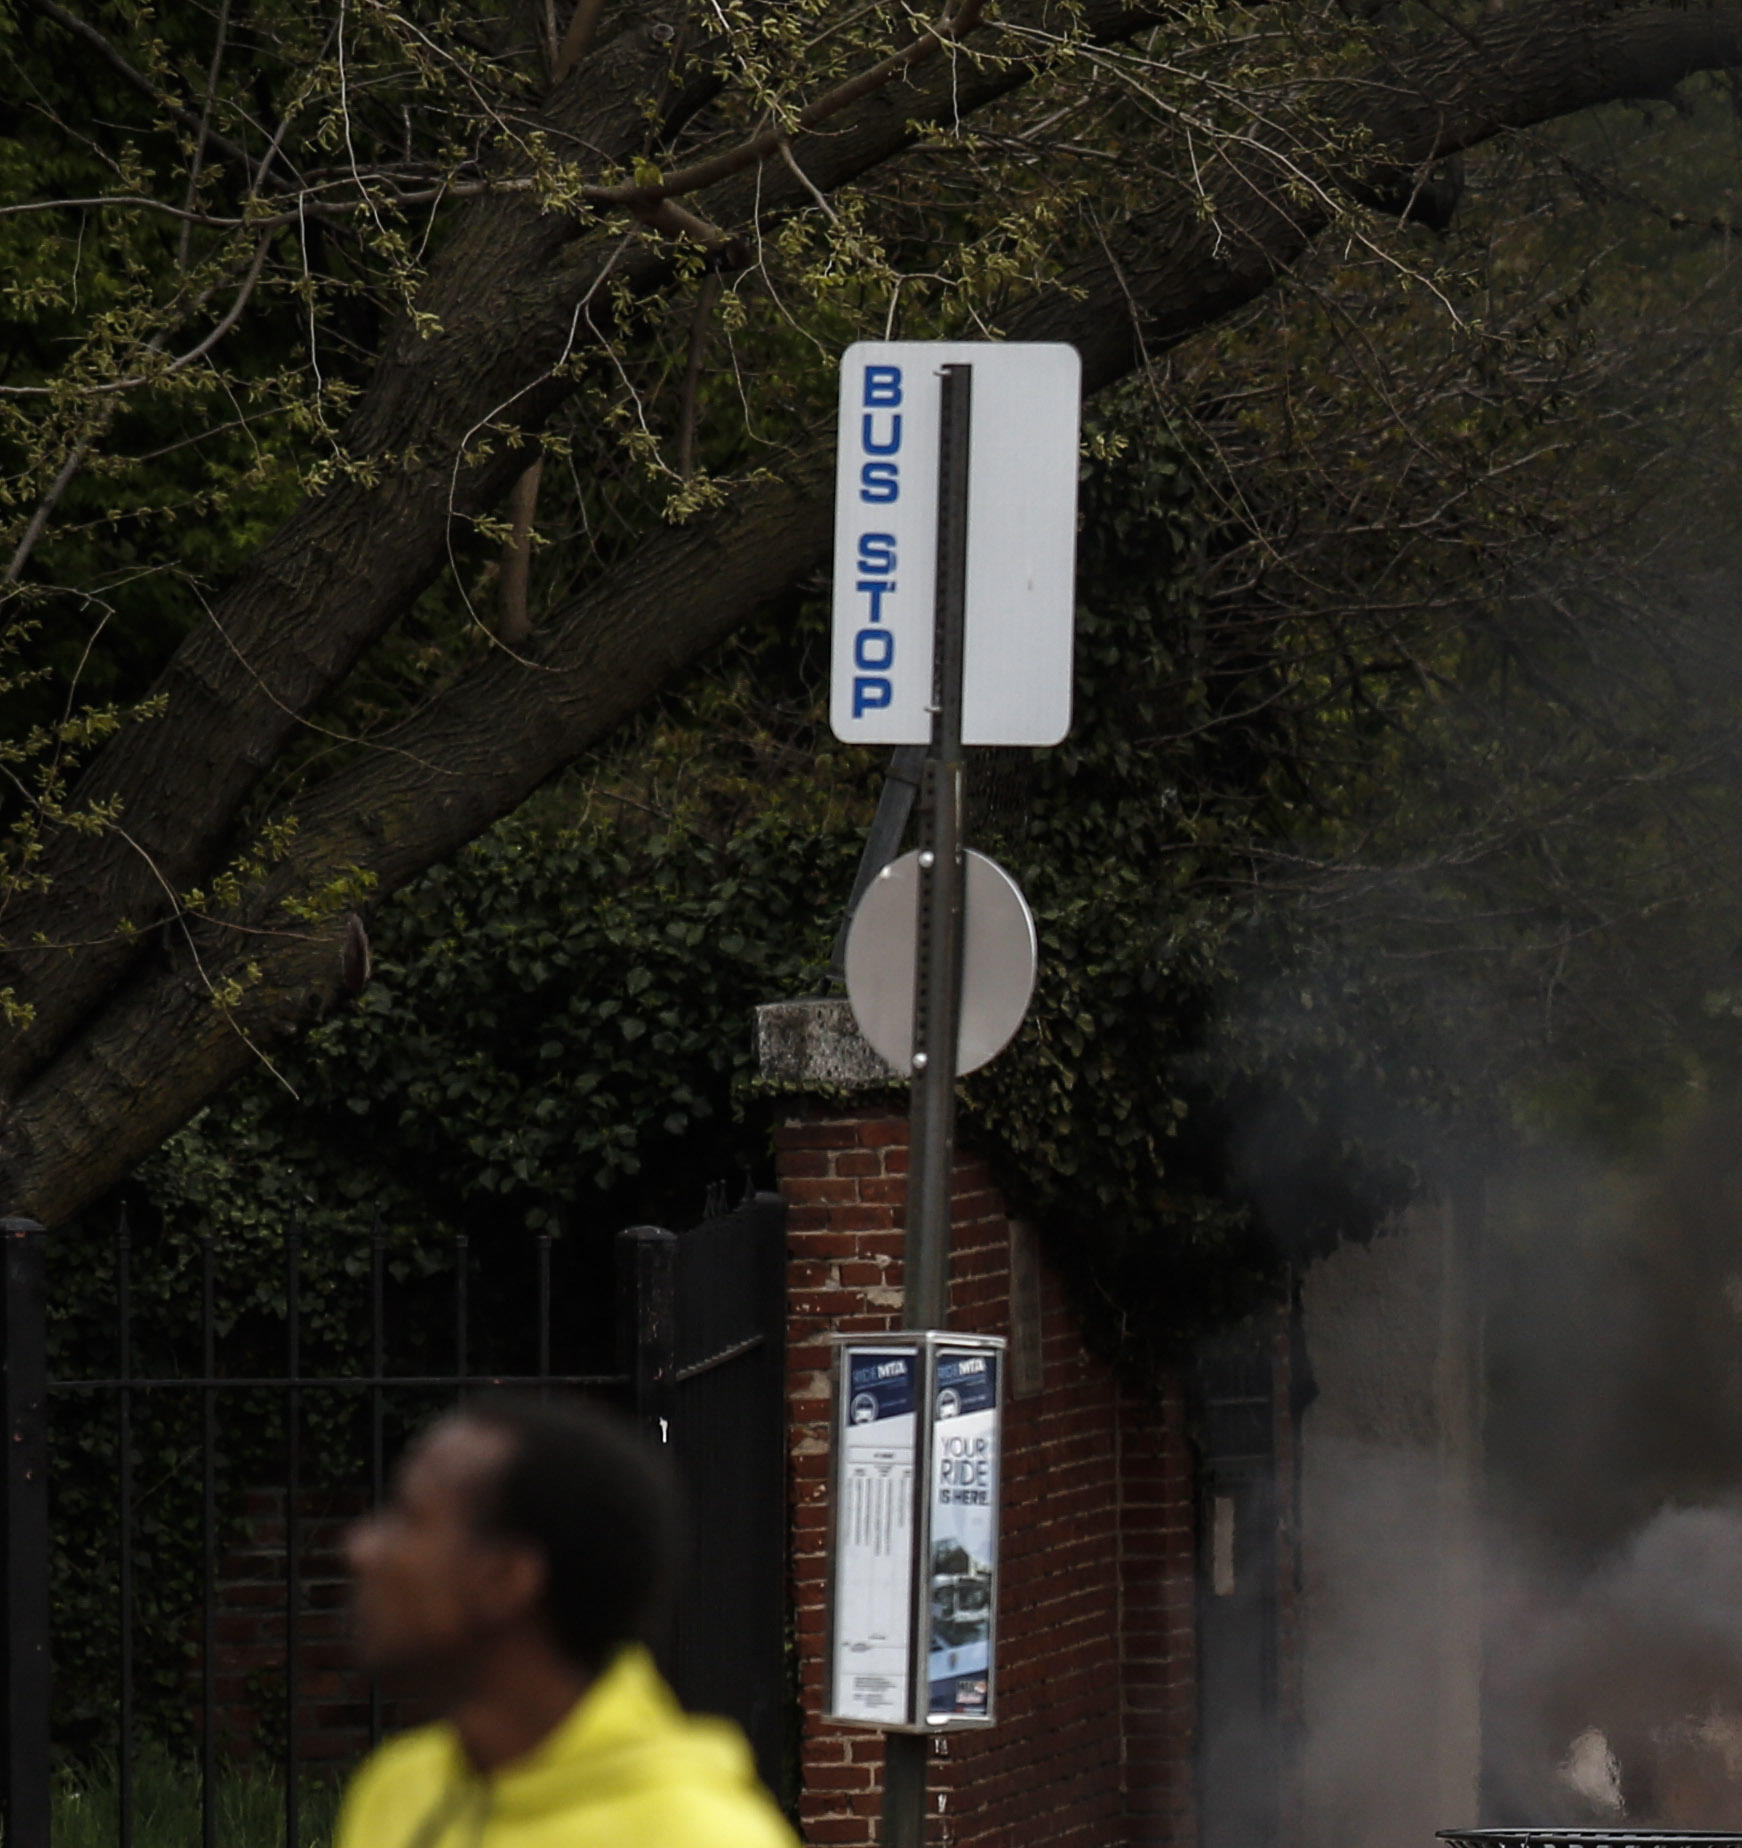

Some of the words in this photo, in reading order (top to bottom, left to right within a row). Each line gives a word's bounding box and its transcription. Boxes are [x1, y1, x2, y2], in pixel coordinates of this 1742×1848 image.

[860, 365, 903, 505] BUS
[852, 532, 899, 719] STOP
[940, 1458, 989, 1486] RIDE
[941, 1436, 989, 1458] YOUR
